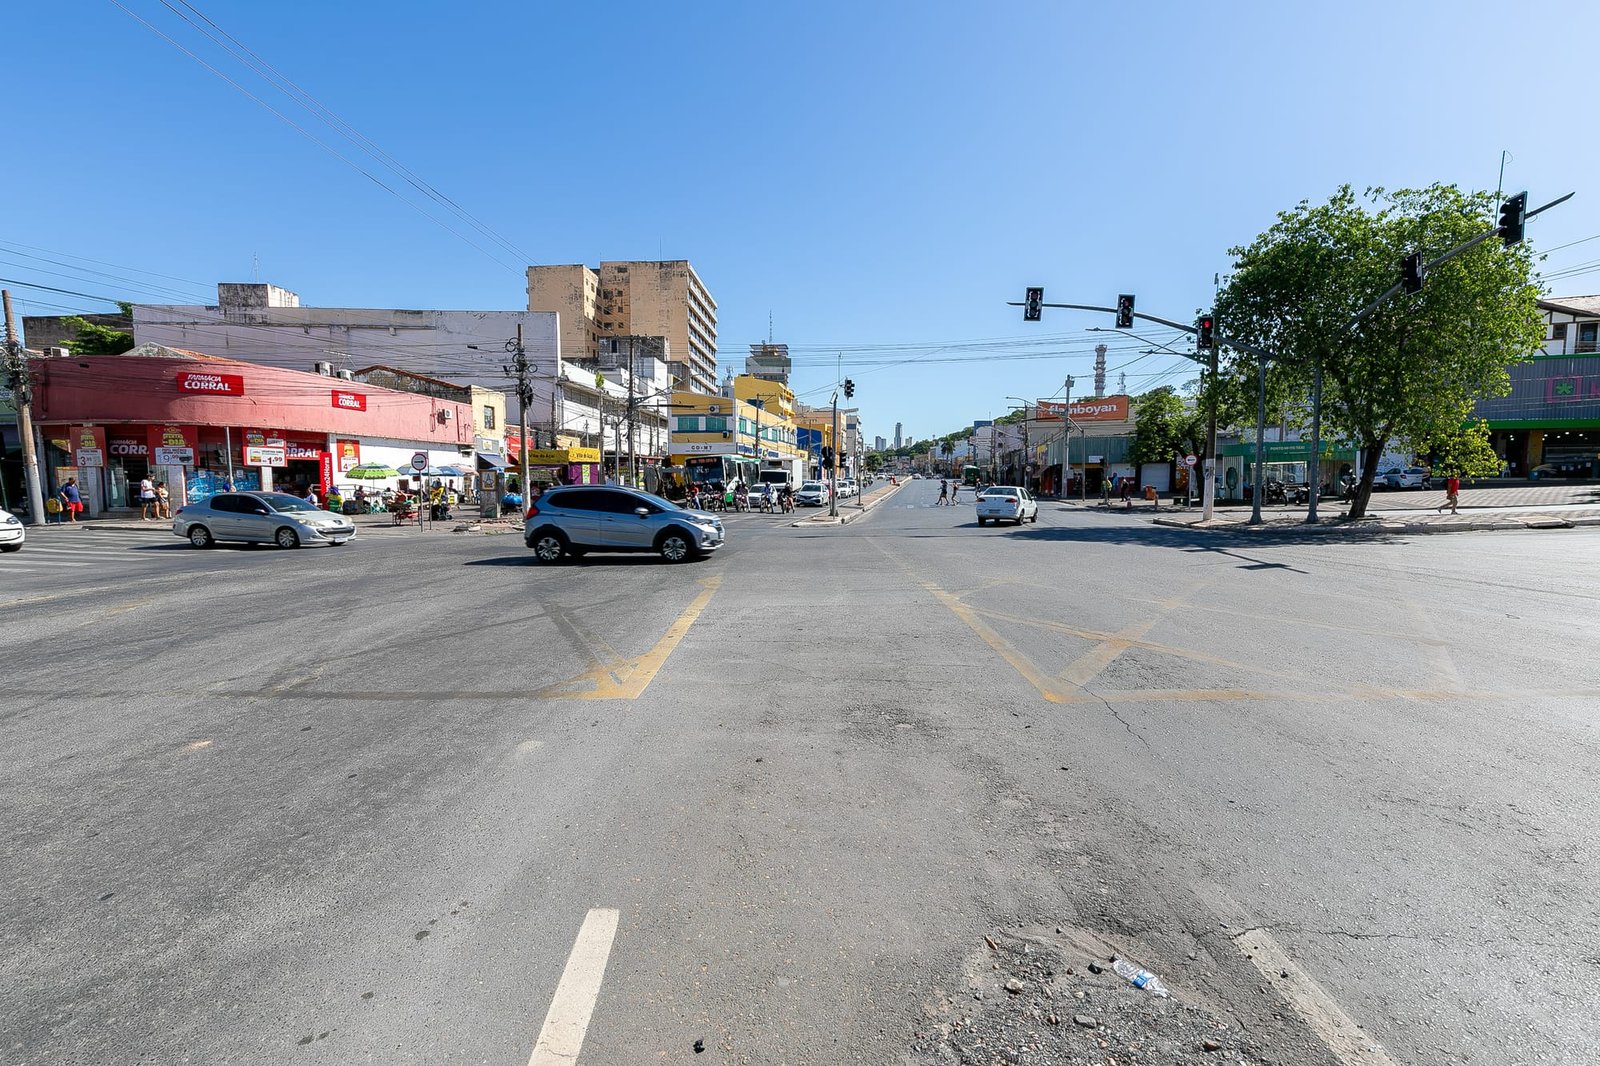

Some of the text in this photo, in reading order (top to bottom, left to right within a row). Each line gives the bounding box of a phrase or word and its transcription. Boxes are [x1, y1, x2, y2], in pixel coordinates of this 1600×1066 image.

[188, 374, 222, 382] FARMÁCIA
[184, 380, 232, 391] CORRAL
[109, 444, 149, 455] CORR
